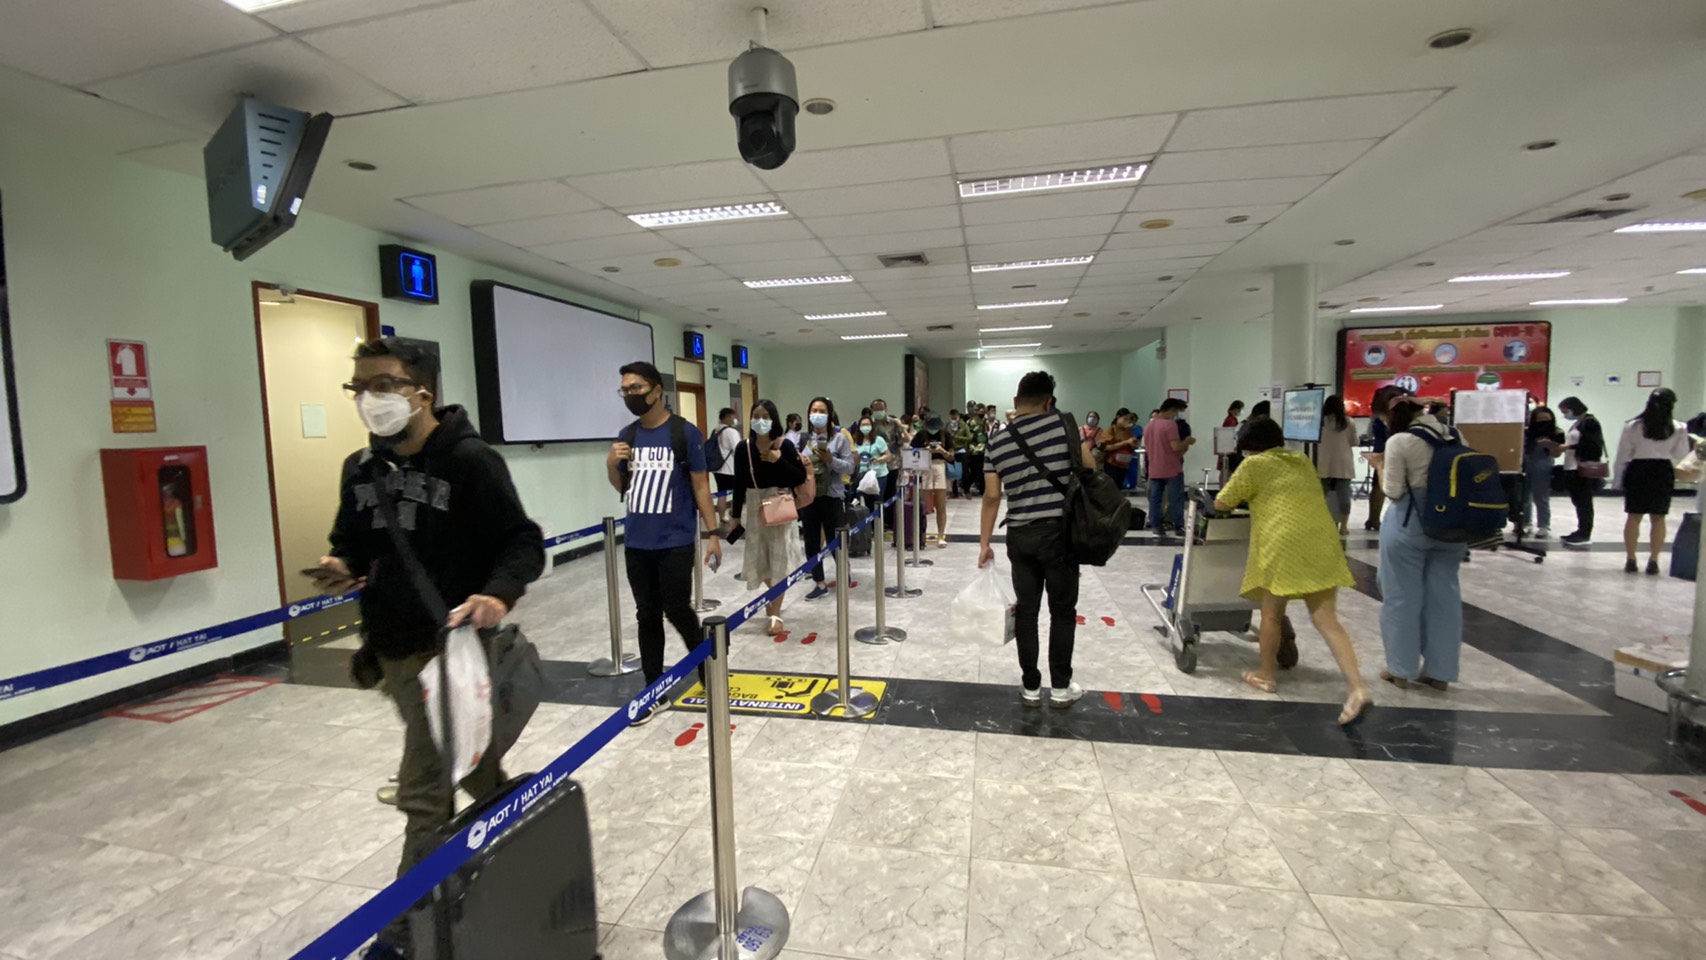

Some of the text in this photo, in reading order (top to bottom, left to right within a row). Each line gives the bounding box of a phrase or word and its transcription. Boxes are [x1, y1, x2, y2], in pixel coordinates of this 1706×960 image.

[648, 447, 672, 461] GUY
[146, 642, 167, 655] AOT
[176, 636, 193, 647] HAT
[487, 804, 511, 832] AOT
[521, 783, 538, 805] HAT
[539, 772, 553, 789] YAI
